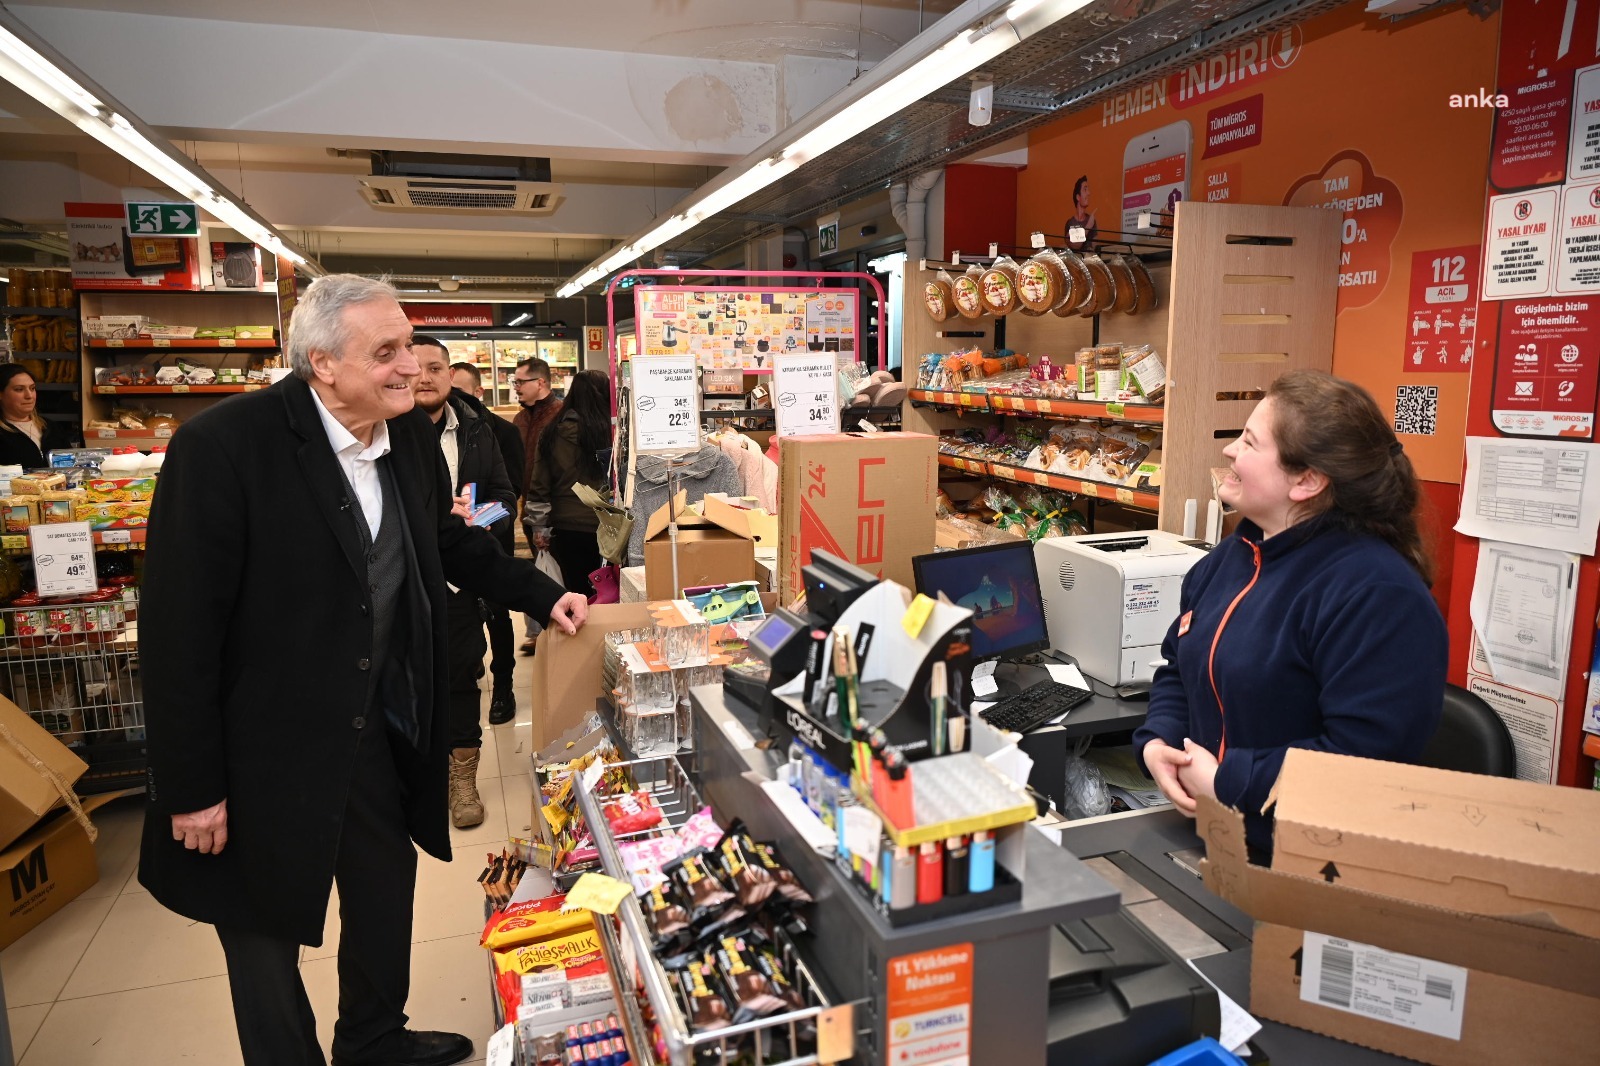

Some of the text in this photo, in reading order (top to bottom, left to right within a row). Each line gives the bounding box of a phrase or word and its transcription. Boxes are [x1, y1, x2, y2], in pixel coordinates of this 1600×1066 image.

[1102, 78, 1166, 128] HEMEN
[1210, 118, 1223, 131] TÜM
[1209, 124, 1256, 147] KAMPANYALARI
[1208, 172, 1228, 187] SALLA
[1323, 176, 1349, 193] TAM
[1207, 188, 1229, 203] KAZAN
[1571, 214, 1597, 227] YASAL
[1498, 222, 1547, 238] YASAL UYARI
[1431, 255, 1466, 283] 112
[1338, 270, 1377, 287] RSATI!
[1514, 302, 1588, 315] Görüşleriniz bizim
[1521, 314, 1579, 327] için önemlidir.
[674, 398, 682, 407] 34
[668, 413, 682, 426] 22
[809, 408, 822, 421] 34
[70, 554, 78, 562] 64
[66, 565, 79, 576] 49
[1472, 683, 1526, 705] Değerli Müşterilerimiz
[9, 843, 49, 902] M
[893, 952, 969, 977] TL Yükleme
[905, 972, 956, 992] Noktası
[914, 1013, 964, 1031] TURKCELL
[913, 1041, 962, 1057] vodafone
